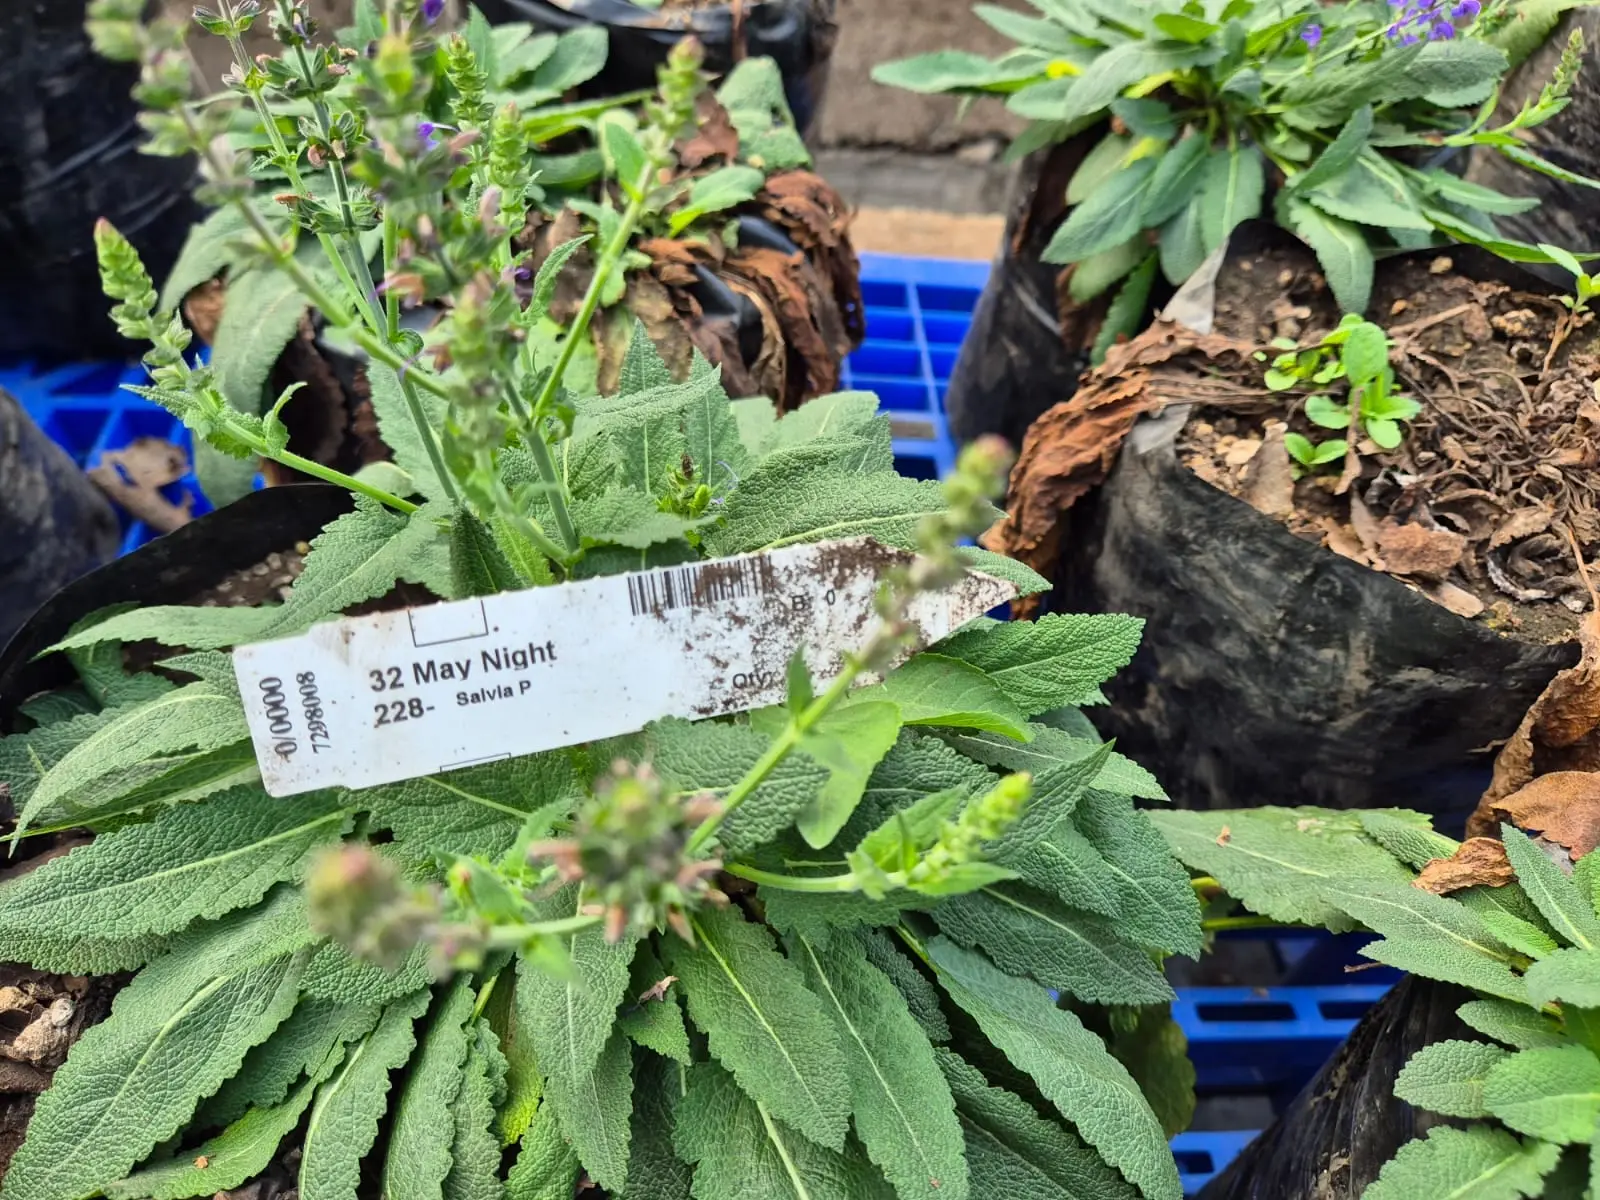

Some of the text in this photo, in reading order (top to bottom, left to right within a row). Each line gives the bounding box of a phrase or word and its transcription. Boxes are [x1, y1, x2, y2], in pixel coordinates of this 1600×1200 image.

[368, 640, 557, 693] 32 May Night
[259, 677, 298, 756] 0/0000
[296, 671, 332, 754] 7298008
[373, 697, 436, 727] 228-
[518, 679, 532, 696] P
